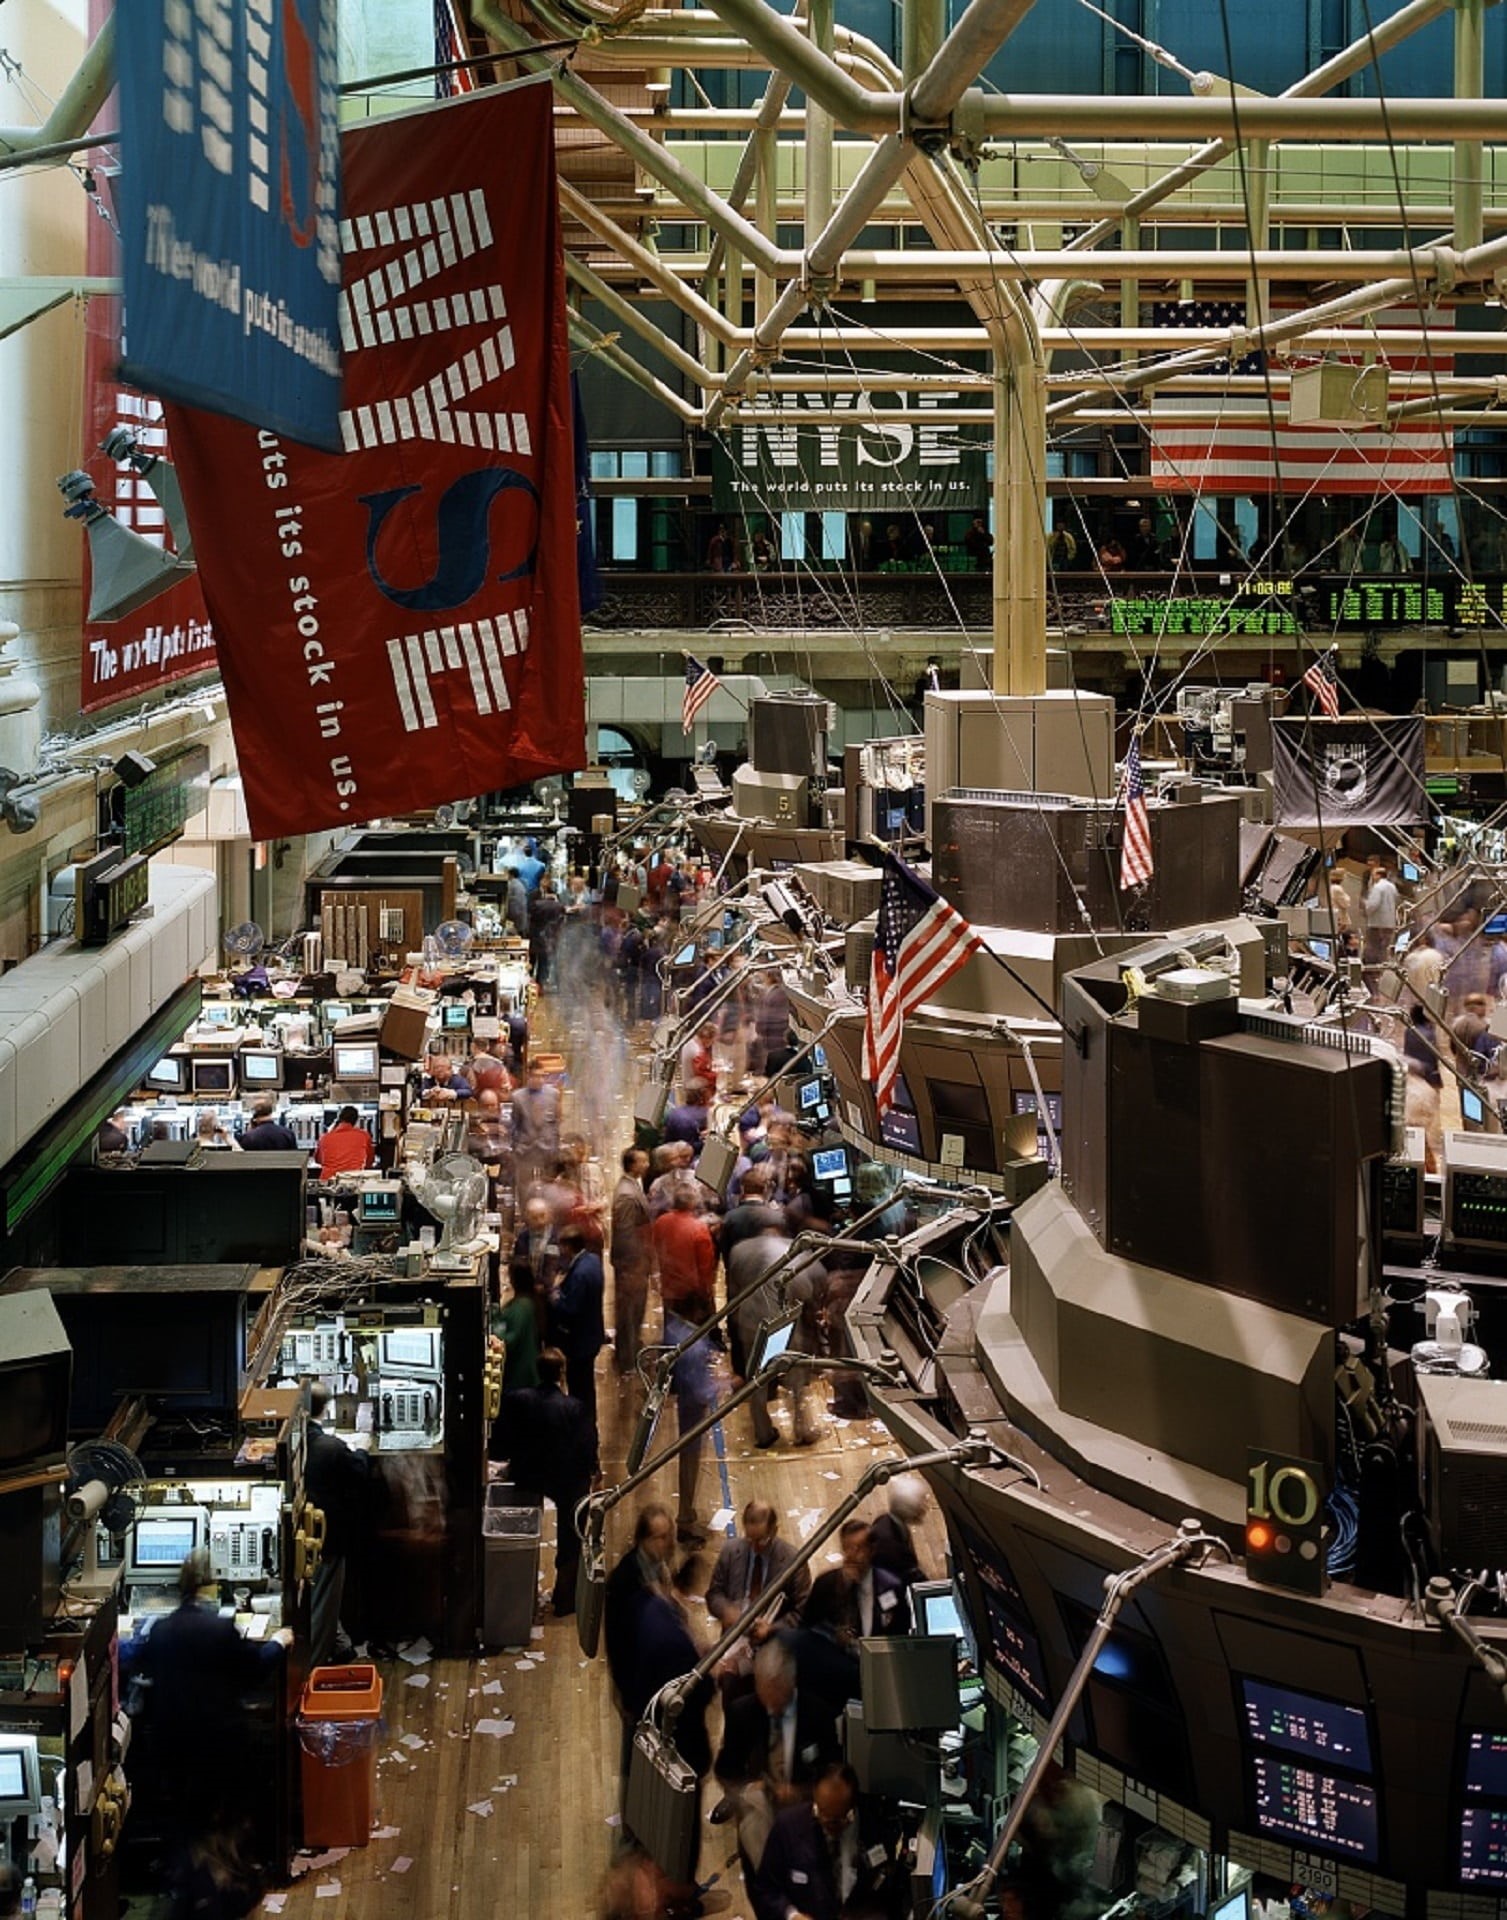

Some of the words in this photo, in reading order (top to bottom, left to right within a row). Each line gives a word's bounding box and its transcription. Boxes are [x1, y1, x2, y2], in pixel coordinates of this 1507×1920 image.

[243, 287, 277, 337] puts
[740, 391, 962, 468] NYSE
[729, 480, 759, 492] The
[766, 480, 809, 492] world
[816, 480, 848, 493] puts
[855, 480, 874, 492] its
[881, 480, 922, 492] stock
[929, 479, 942, 491] in
[948, 478, 971, 490] us.
[257, 429, 288, 489] uts
[275, 505, 303, 558] its
[289, 575, 336, 687] stock
[316, 700, 344, 738] in
[330, 755, 357, 811] us.
[89, 638, 118, 684] The
[779, 796, 789, 812] 5
[1248, 1461, 1318, 1526] 10
